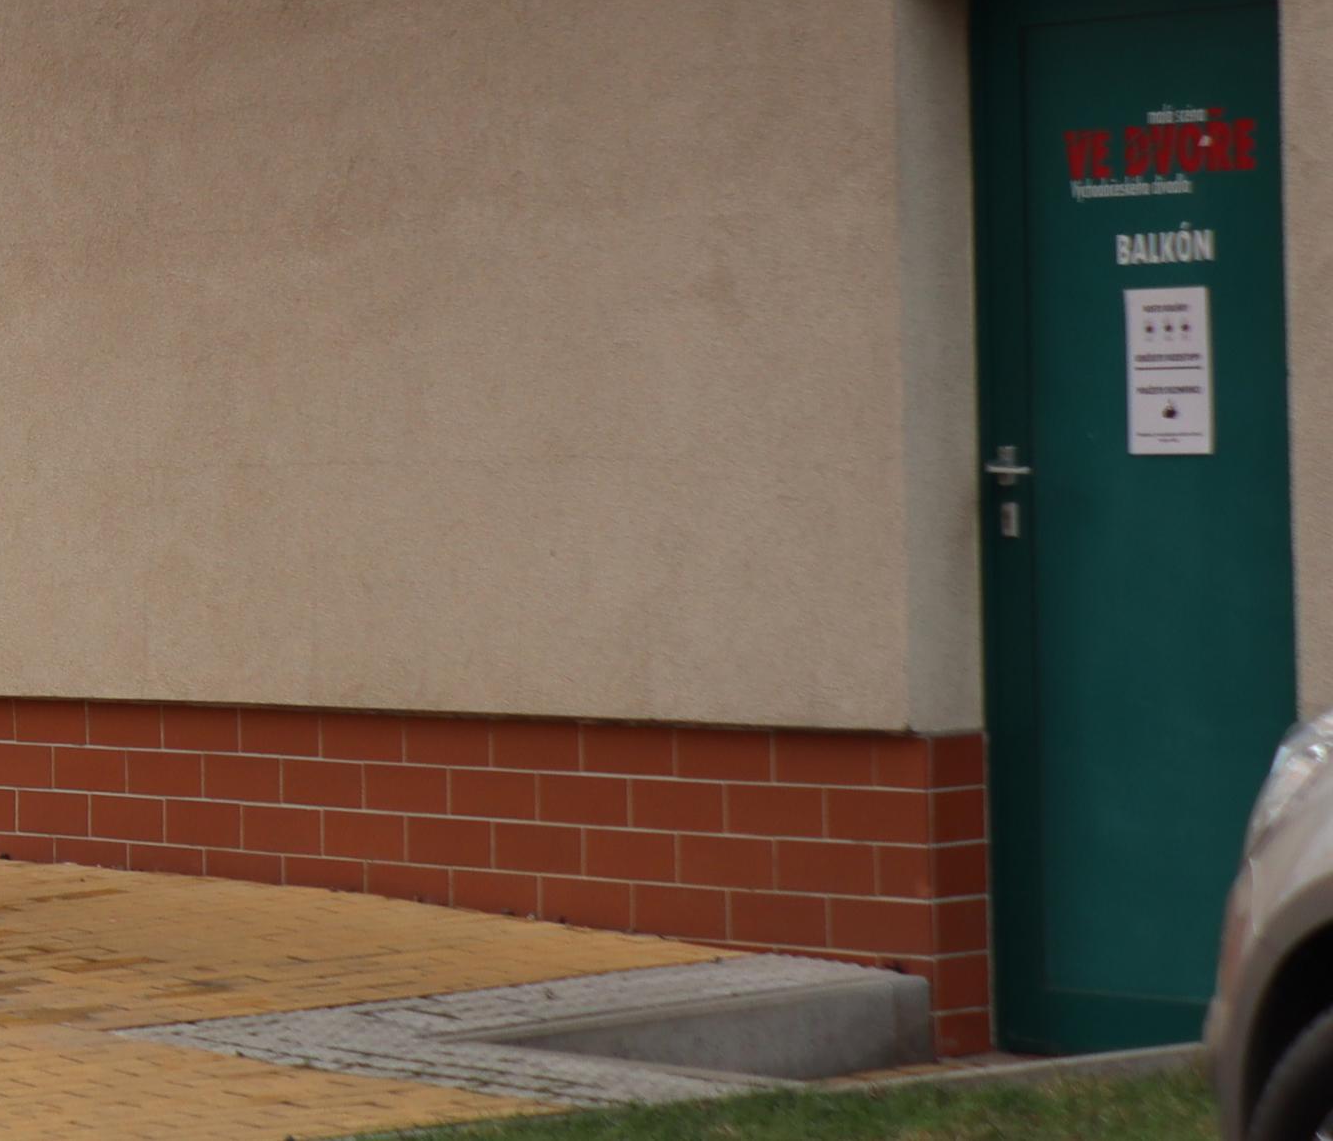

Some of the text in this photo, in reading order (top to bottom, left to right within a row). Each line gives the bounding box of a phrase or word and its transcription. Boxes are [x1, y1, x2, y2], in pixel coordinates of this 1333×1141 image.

[1064, 108, 1257, 180] VE DVOŘE
[1116, 221, 1215, 265] BALKÓN
